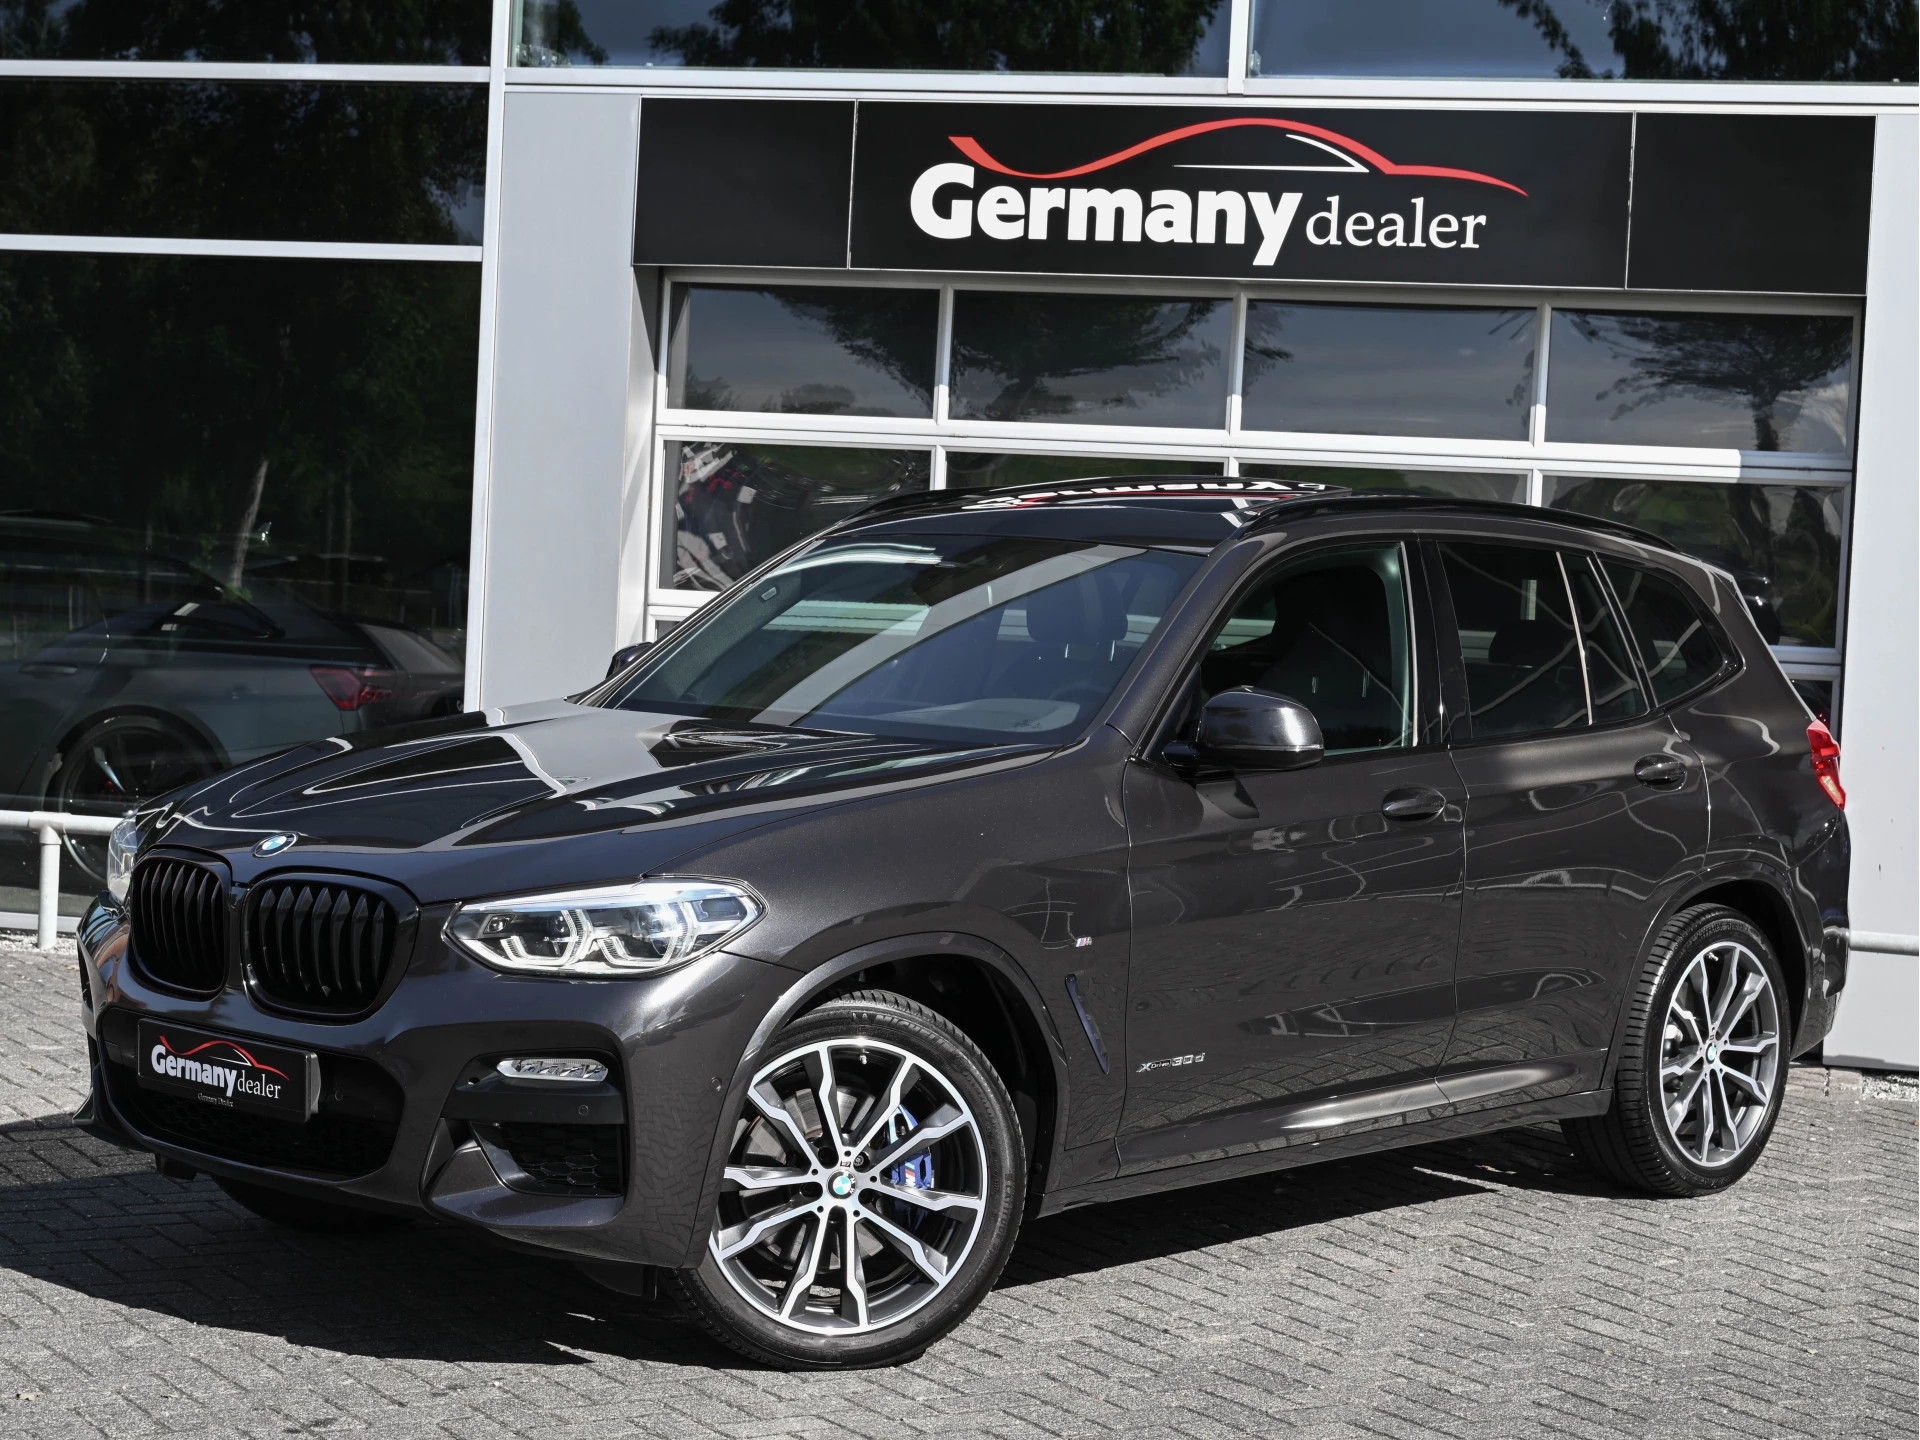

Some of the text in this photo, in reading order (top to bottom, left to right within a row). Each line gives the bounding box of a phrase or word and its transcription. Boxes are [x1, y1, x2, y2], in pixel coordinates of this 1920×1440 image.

[910, 162, 1487, 266] Germany dealer
[151, 1044, 282, 1099] Germany dealer
